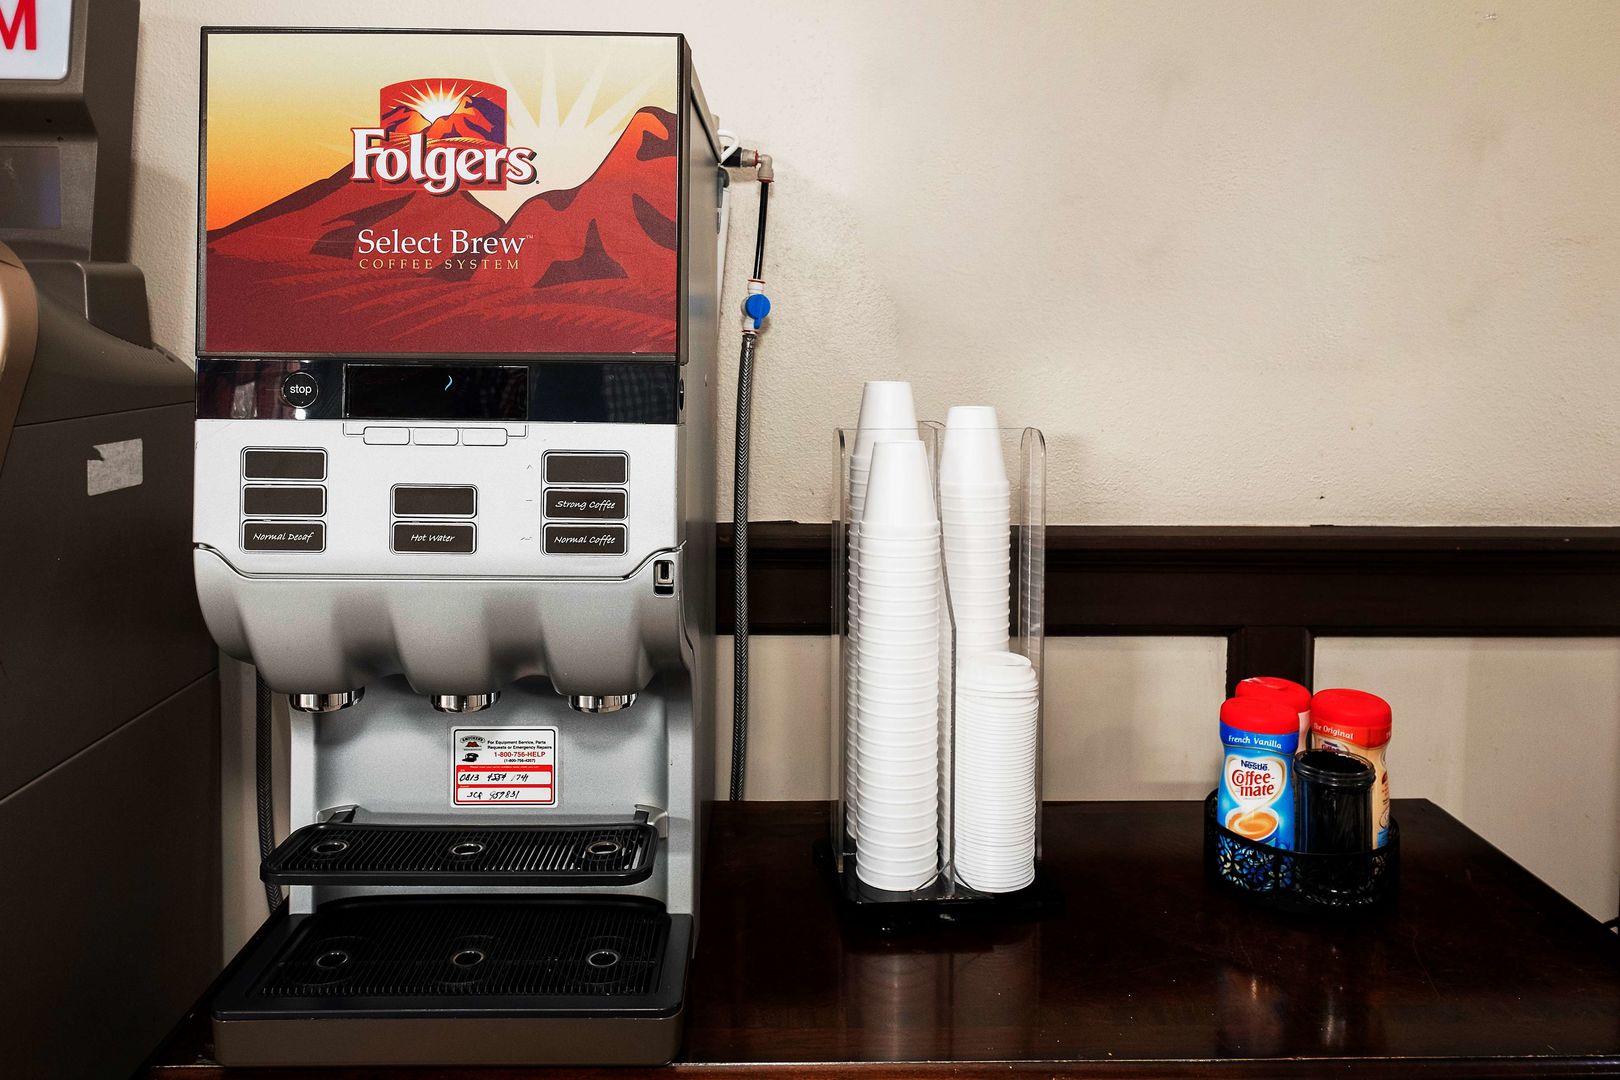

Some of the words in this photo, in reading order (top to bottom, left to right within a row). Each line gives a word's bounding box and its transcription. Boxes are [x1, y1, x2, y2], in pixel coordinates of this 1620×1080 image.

[351, 127, 538, 197] Folgers
[358, 229, 442, 254] Select
[359, 259, 433, 270] COFFEE
[444, 259, 520, 270] SYSTEM
[290, 384, 312, 396] stop
[555, 500, 587, 511] Strong
[588, 500, 616, 511] Coffee
[252, 532, 287, 542] Normal
[287, 531, 315, 543] Decaf
[410, 533, 427, 543] Hot
[427, 533, 456, 543] Water
[553, 535, 588, 544] Normal
[588, 534, 616, 546] Coffee
[1323, 725, 1354, 740] Original
[1228, 734, 1251, 744] French
[1253, 737, 1282, 749] Vanilla
[1240, 784, 1275, 797] mate
